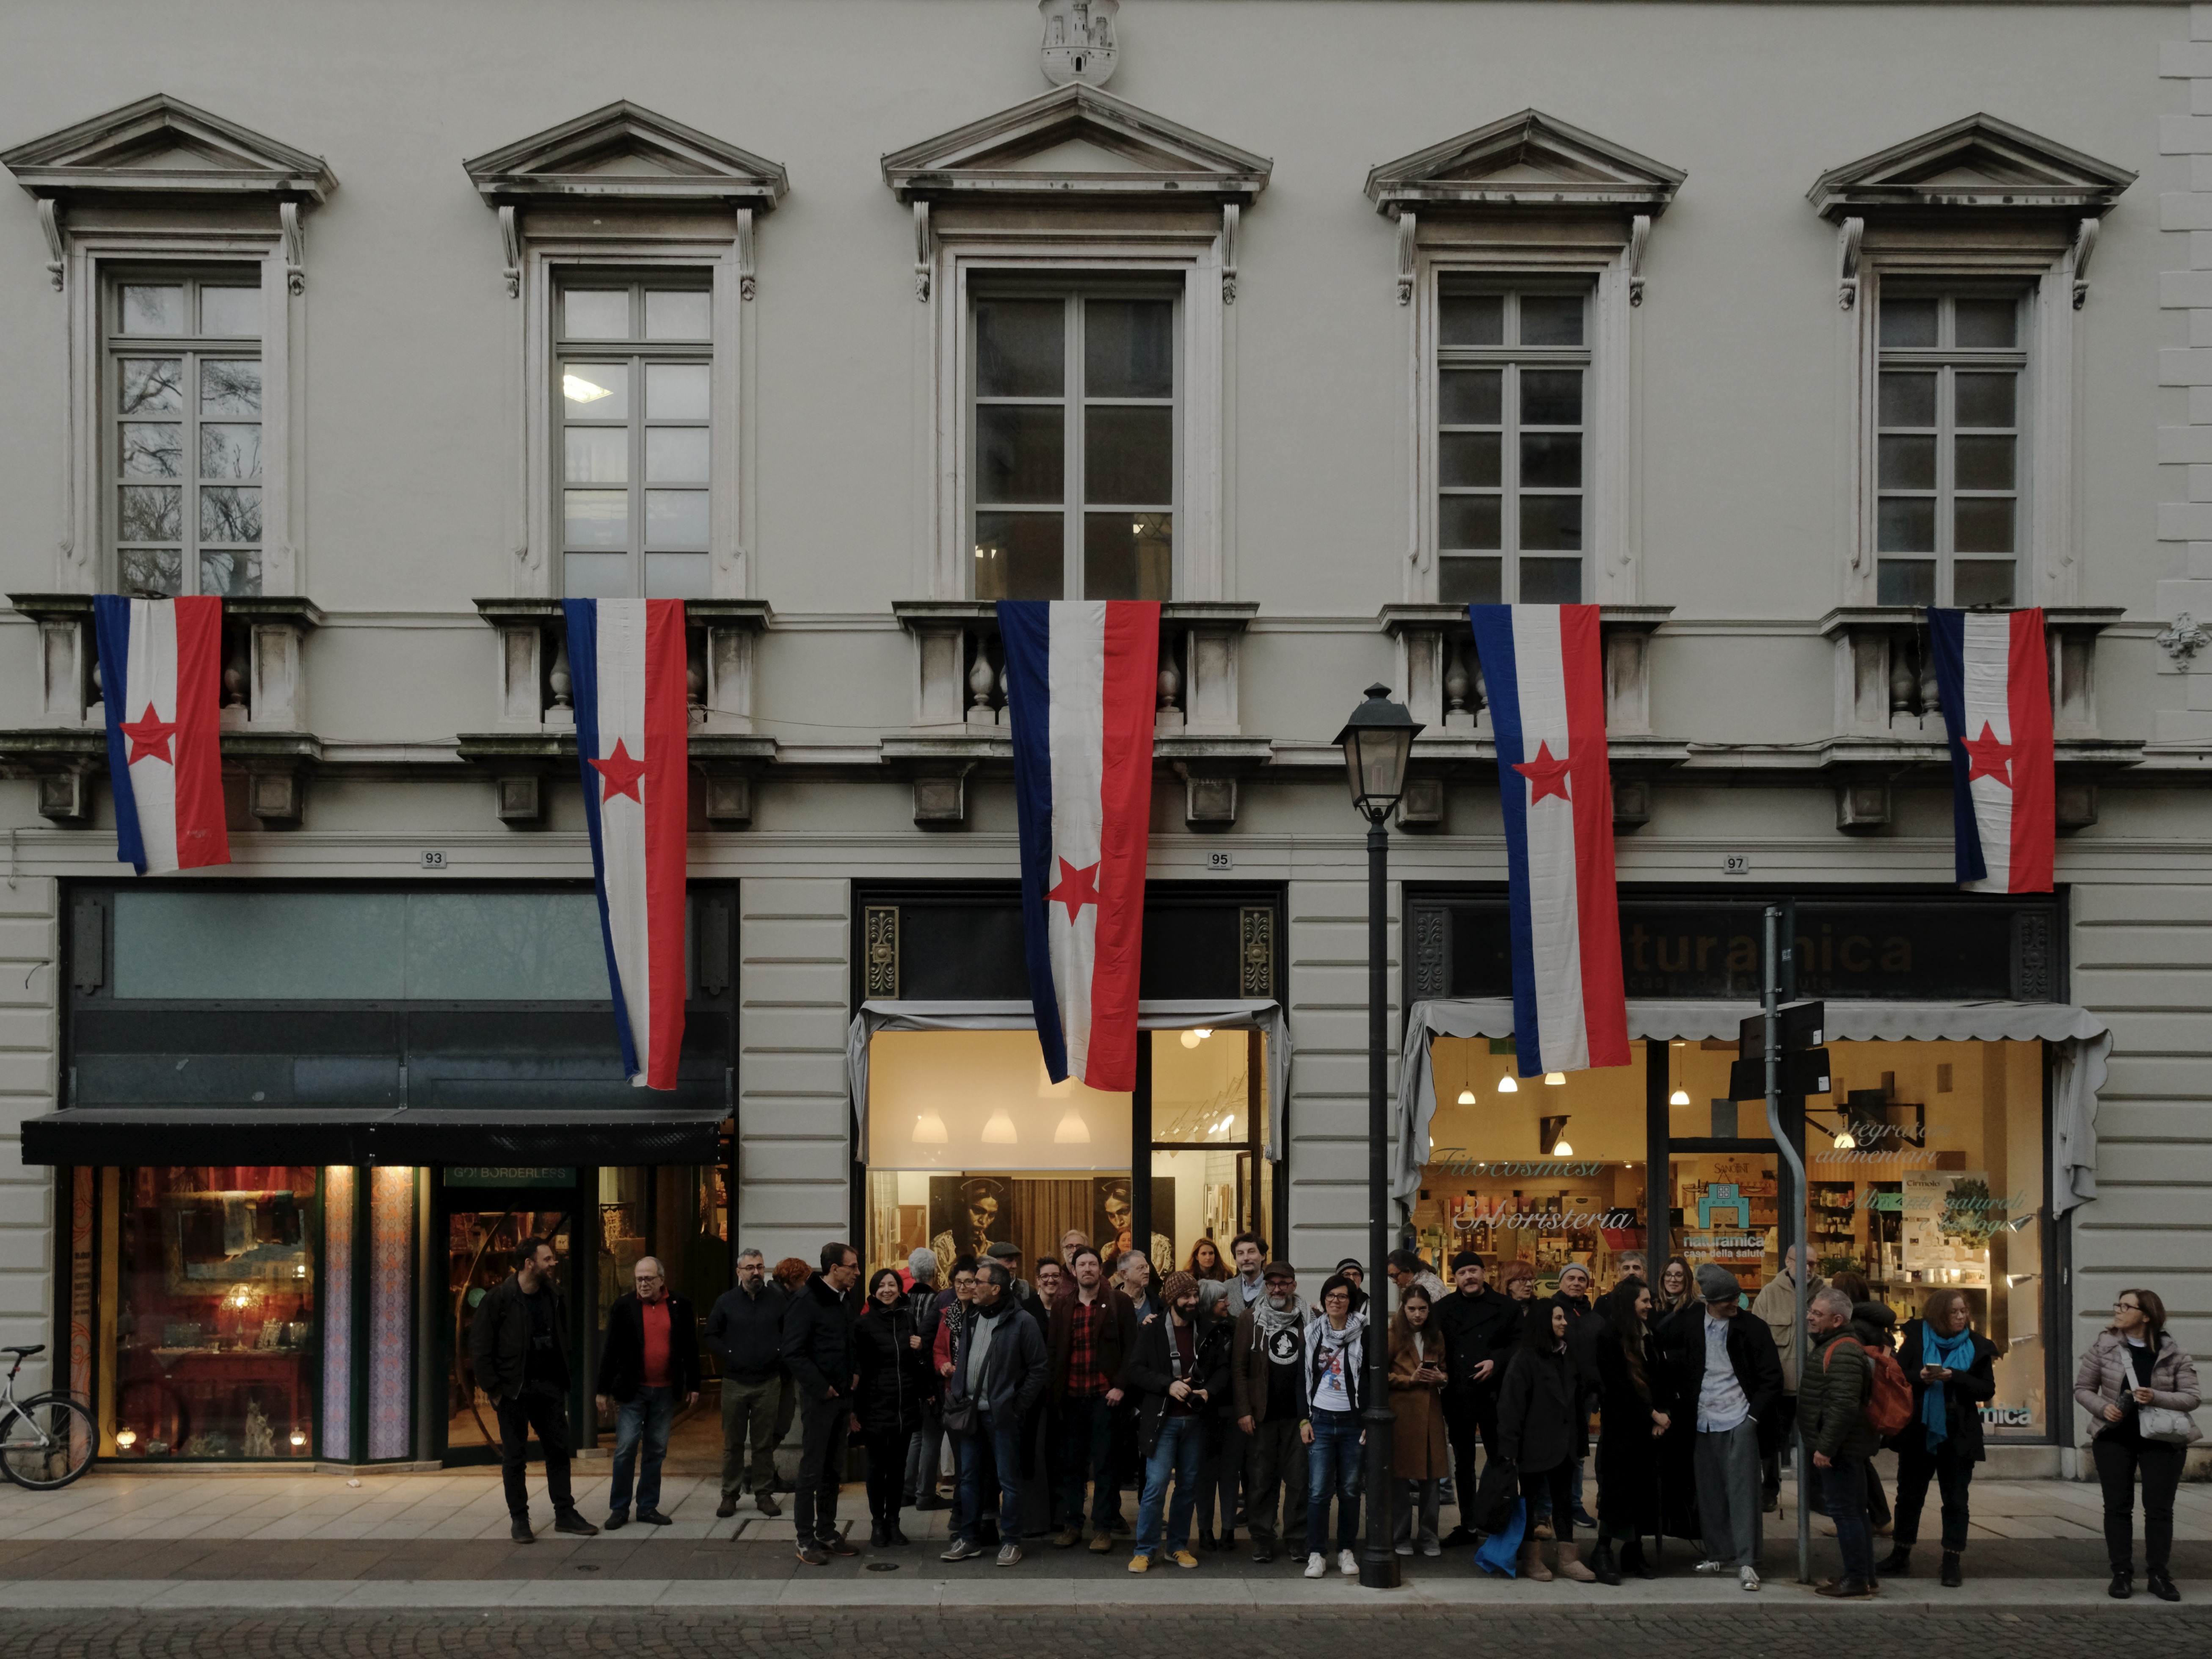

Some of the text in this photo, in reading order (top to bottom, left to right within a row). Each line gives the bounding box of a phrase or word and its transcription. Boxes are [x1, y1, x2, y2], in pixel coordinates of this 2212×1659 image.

[426, 853, 441, 863] 93
[1212, 854, 1227, 865] 95
[1728, 858, 1743, 868] 97
[1815, 1140, 1941, 1164] alimentari
[1424, 1147, 1605, 1177] Fitocosmesi
[480, 1167, 565, 1178] BORDERLESS
[1943, 1190, 2026, 1210] naturali
[1453, 1199, 1634, 1230] Erboristeria
[1938, 1211, 2023, 1239] biologi
[1683, 1233, 1765, 1247] naturamica
[1710, 1249, 1733, 1257] della
[1736, 1249, 1765, 1257] salute
